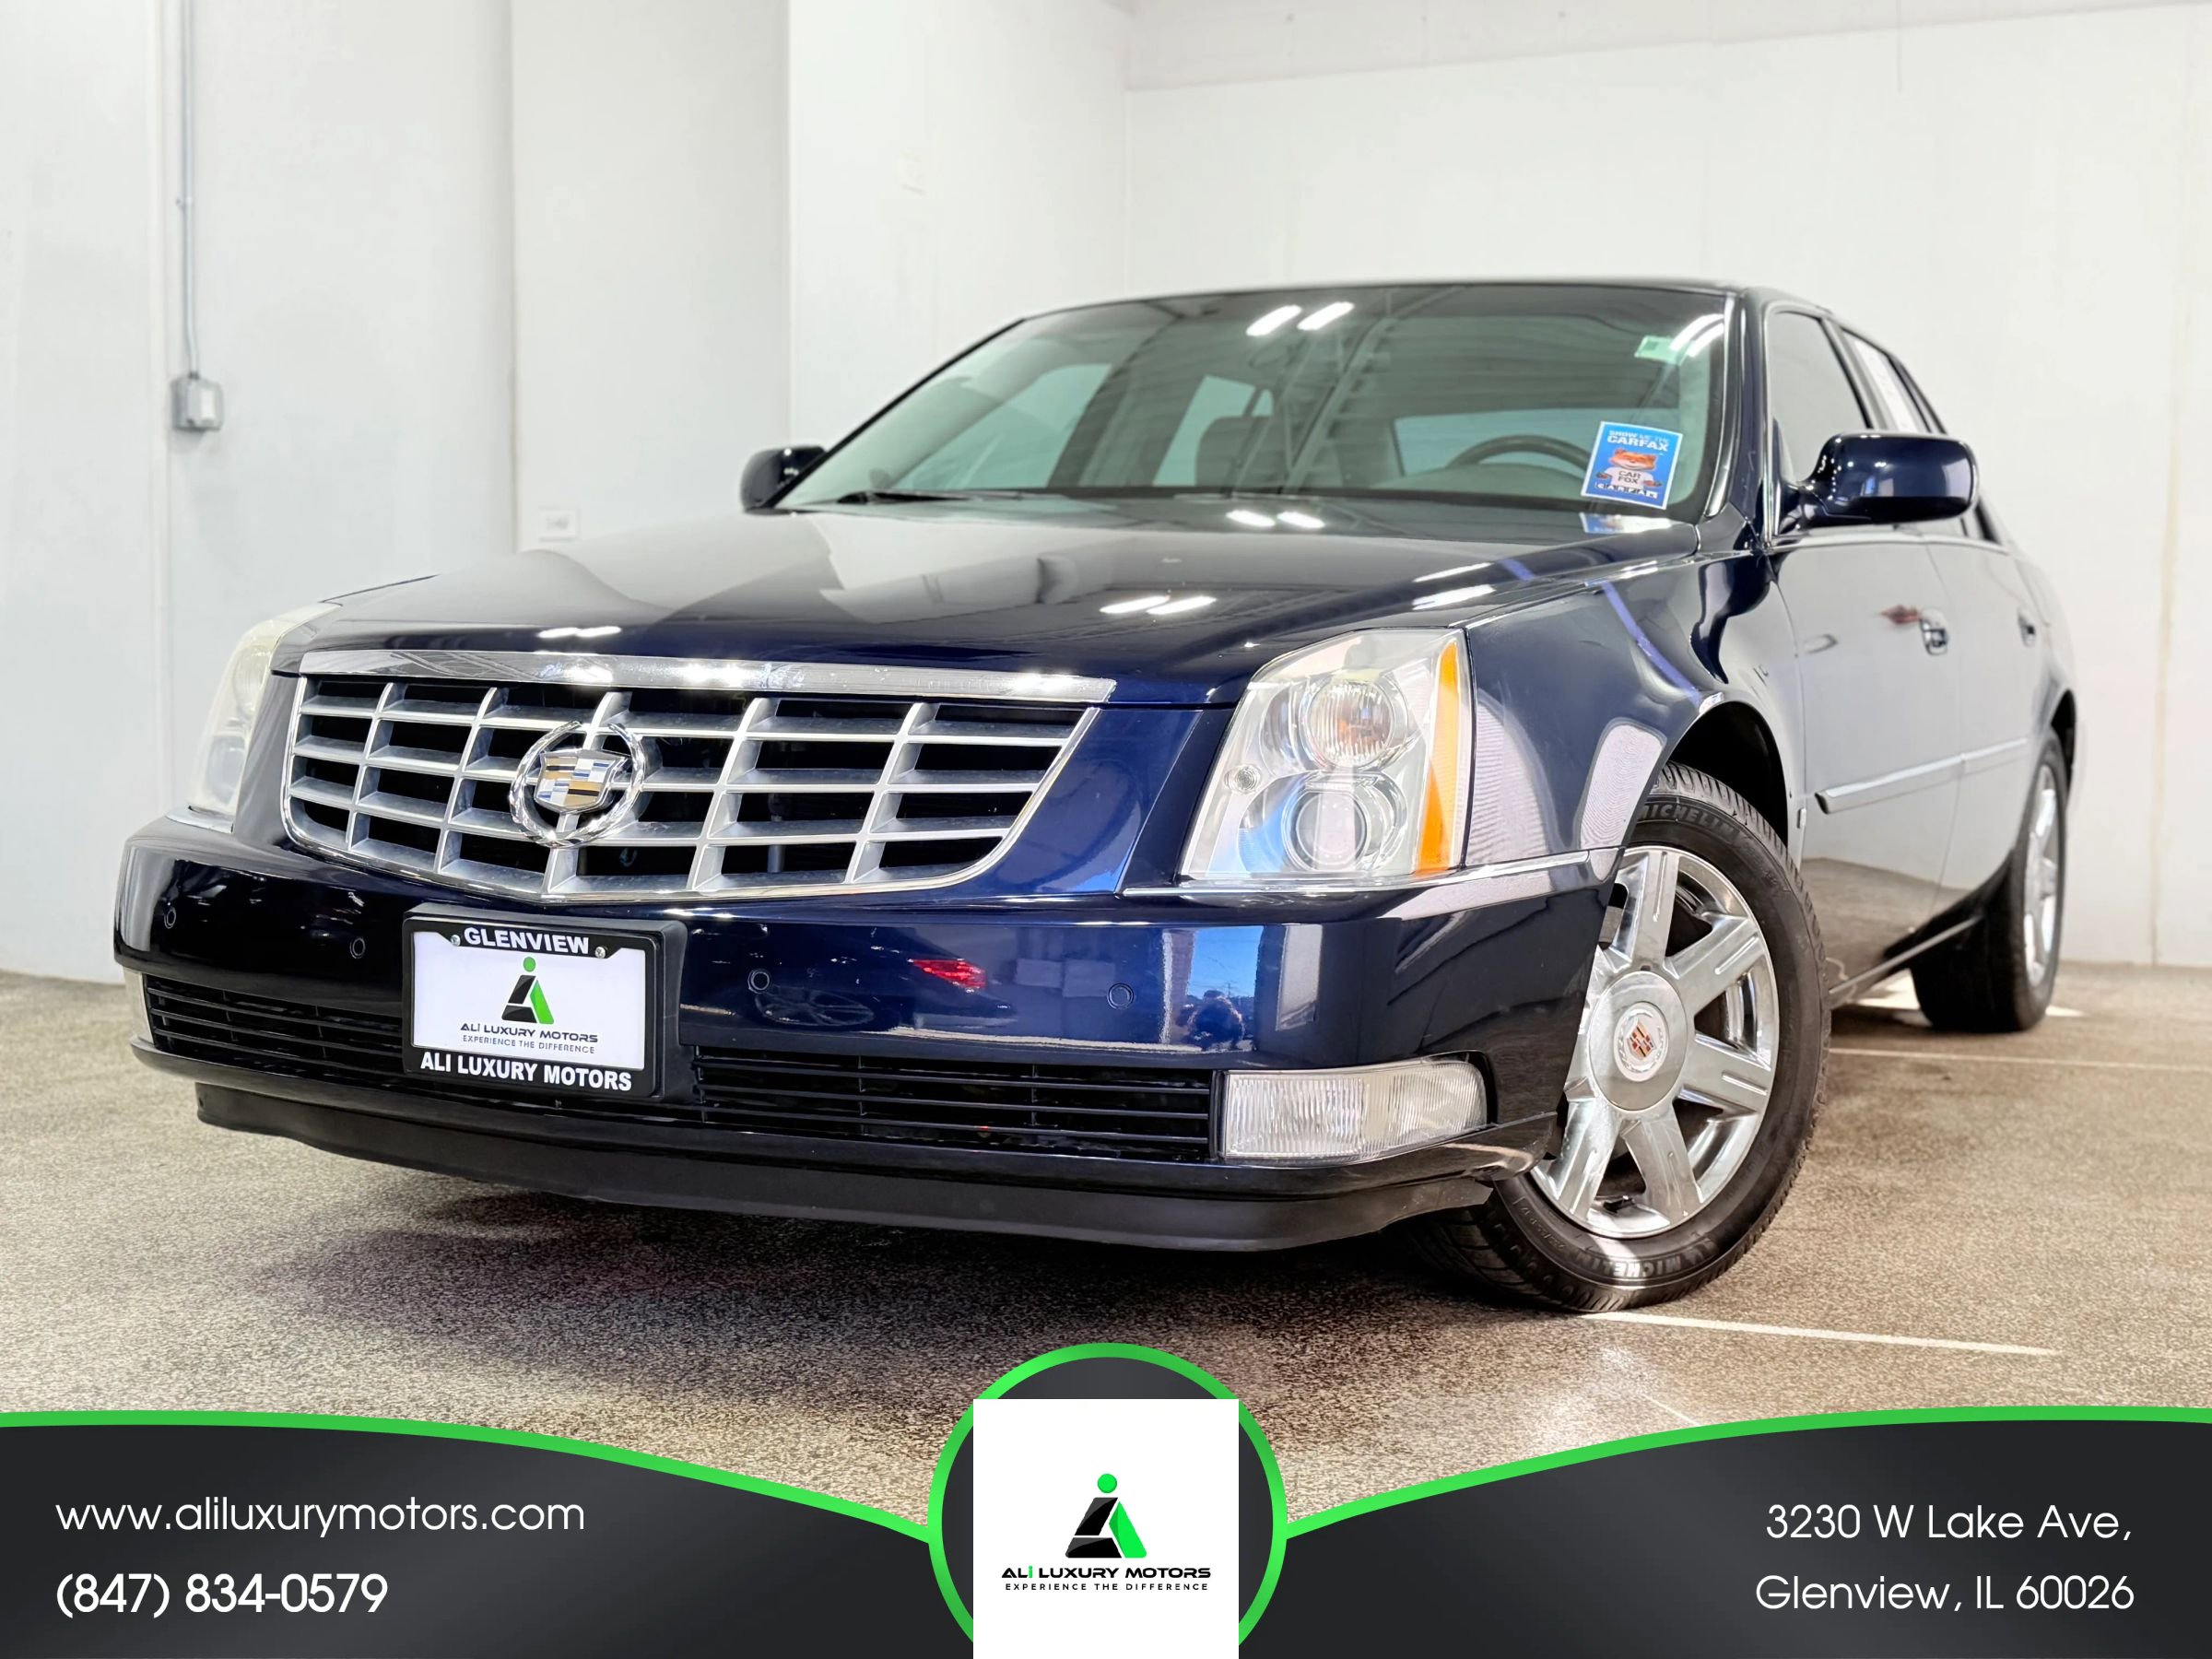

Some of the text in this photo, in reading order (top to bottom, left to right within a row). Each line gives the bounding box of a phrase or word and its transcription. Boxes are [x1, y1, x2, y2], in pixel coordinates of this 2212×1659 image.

[1606, 435, 1669, 452] CARFAX
[1618, 470, 1641, 479] CAR
[1618, 476, 1639, 484] FOX
[464, 926, 590, 955] GLENVIEW
[484, 1025, 536, 1038] LUXURY
[539, 1030, 599, 1043] MOTORS
[463, 1034, 595, 1054] EXPERIENCE THE DIFFERENCE
[420, 1052, 632, 1091] ALI LUXURY MOTORS
